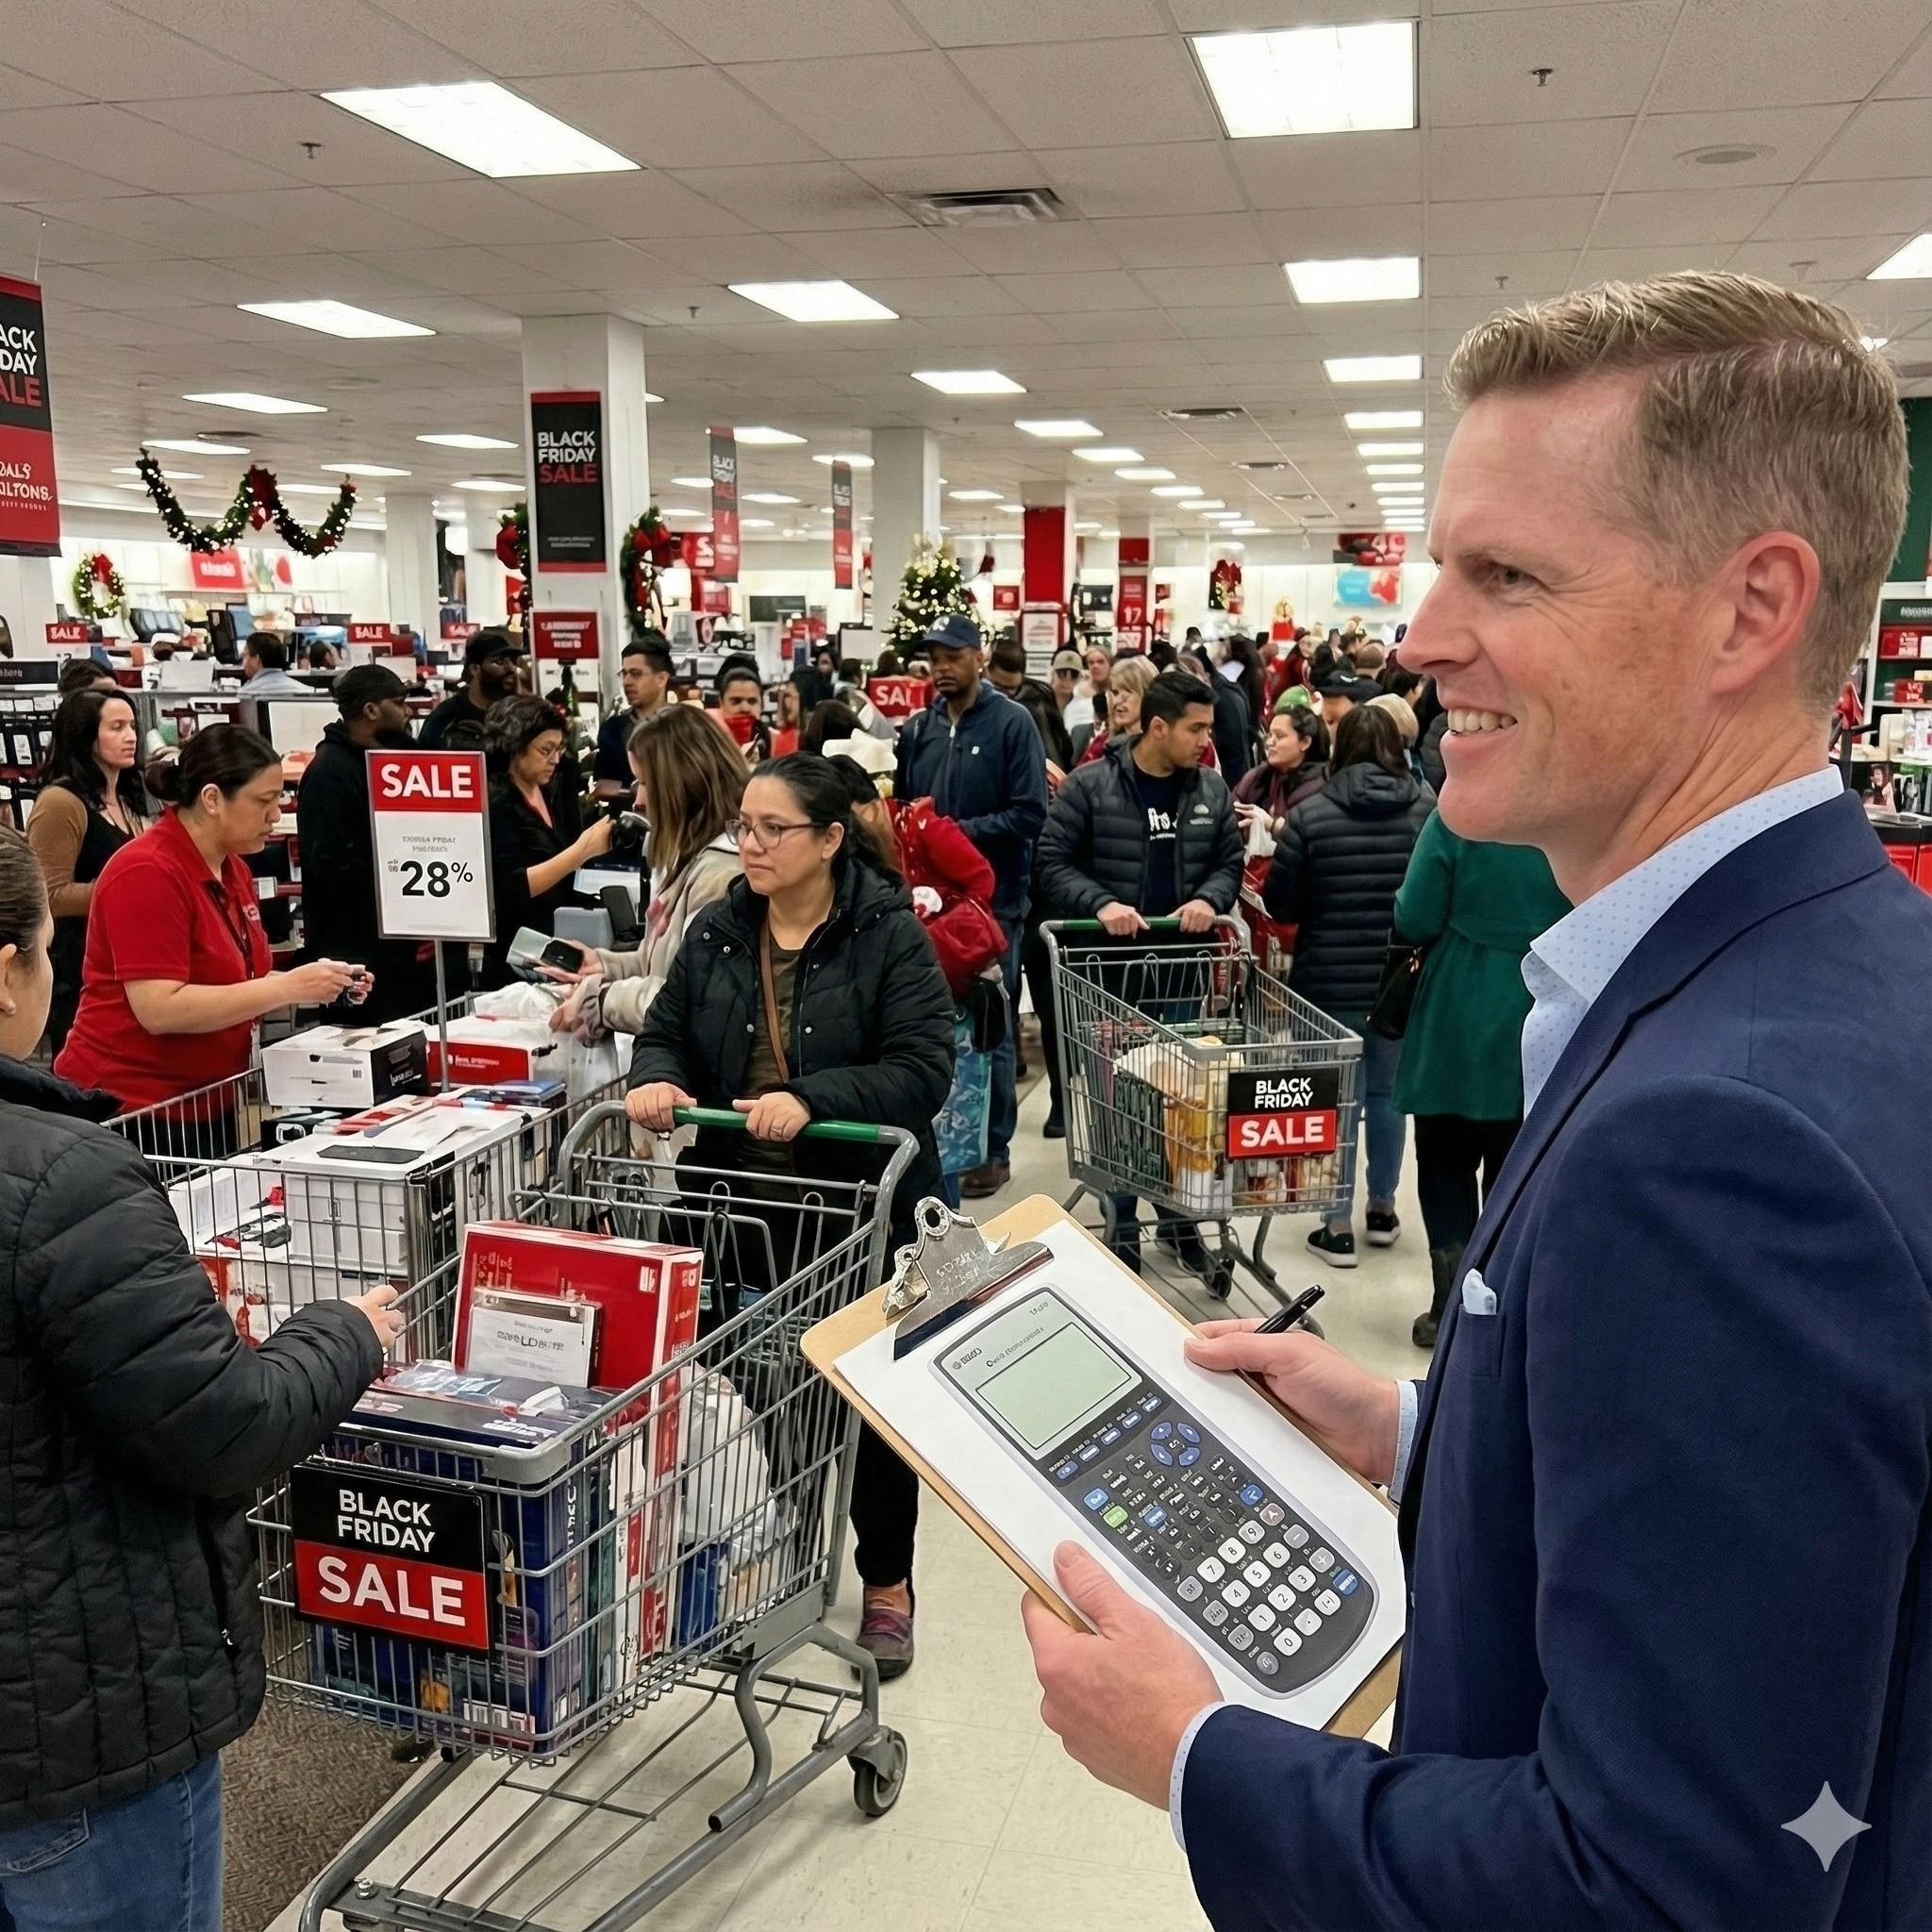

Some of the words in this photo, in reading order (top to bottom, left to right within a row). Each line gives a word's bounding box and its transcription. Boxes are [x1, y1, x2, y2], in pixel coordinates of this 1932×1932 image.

[0, 348, 38, 375] DAY
[537, 430, 596, 447] BLACK
[538, 447, 596, 463] FRIDAY
[539, 463, 598, 484] SALE
[50, 626, 81, 640] SALE
[355, 625, 384, 640] SALE
[380, 763, 474, 798] SALE
[1256, 1077, 1311, 1094] BLACK
[1254, 1091, 1313, 1108] FRIDAY
[1241, 1115, 1324, 1148] SALE
[339, 1489, 432, 1526] BLACK
[337, 1514, 436, 1553] FRIDAY
[1247, 1527, 1257, 1537] 9
[1227, 1546, 1238, 1557] 8
[1273, 1550, 1282, 1559] 6
[1207, 1565, 1217, 1575] 7
[1252, 1570, 1262, 1579] 5
[1297, 1574, 1307, 1584] 3
[318, 1556, 466, 1627] SALE
[1232, 1589, 1241, 1599] 4
[1277, 1592, 1289, 1604] 2
[1258, 1614, 1267, 1623] 1
[1284, 1638, 1293, 1647] 0
